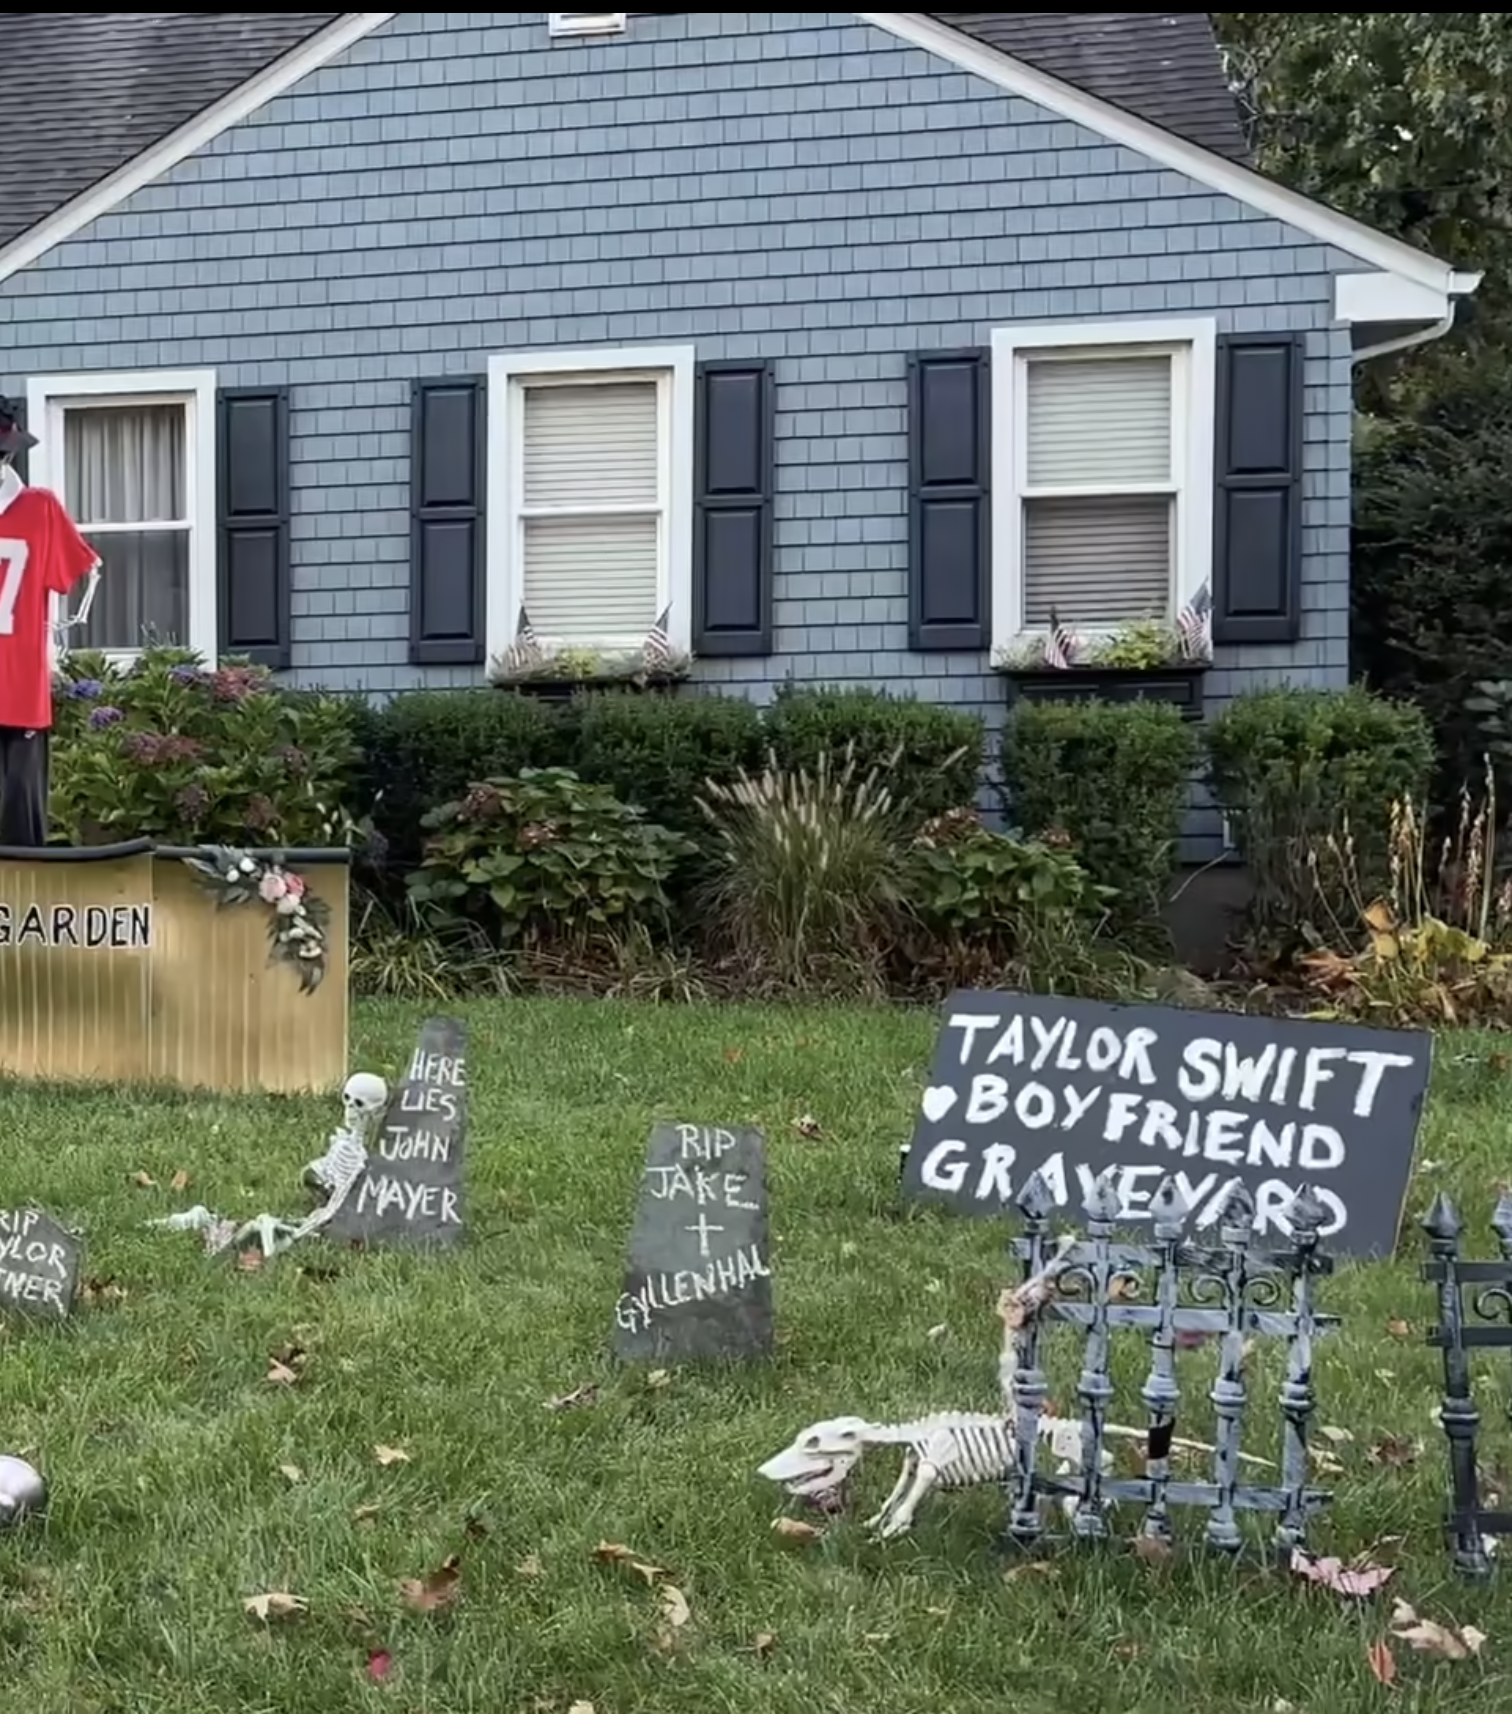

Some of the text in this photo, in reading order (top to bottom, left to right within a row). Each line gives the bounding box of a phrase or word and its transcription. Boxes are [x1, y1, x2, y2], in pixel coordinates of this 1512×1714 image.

[409, 1047, 466, 1087] HERE
[948, 1013, 1414, 1117] TAYLOR SWIFT
[400, 1086, 458, 1122] LIES
[964, 1074, 1346, 1169] BOYFRIEND
[675, 1123, 737, 1161] RIP
[356, 1174, 463, 1224] MAYER
[645, 1163, 761, 1210] JAKE
[615, 1243, 771, 1334] GYLLENHAL
